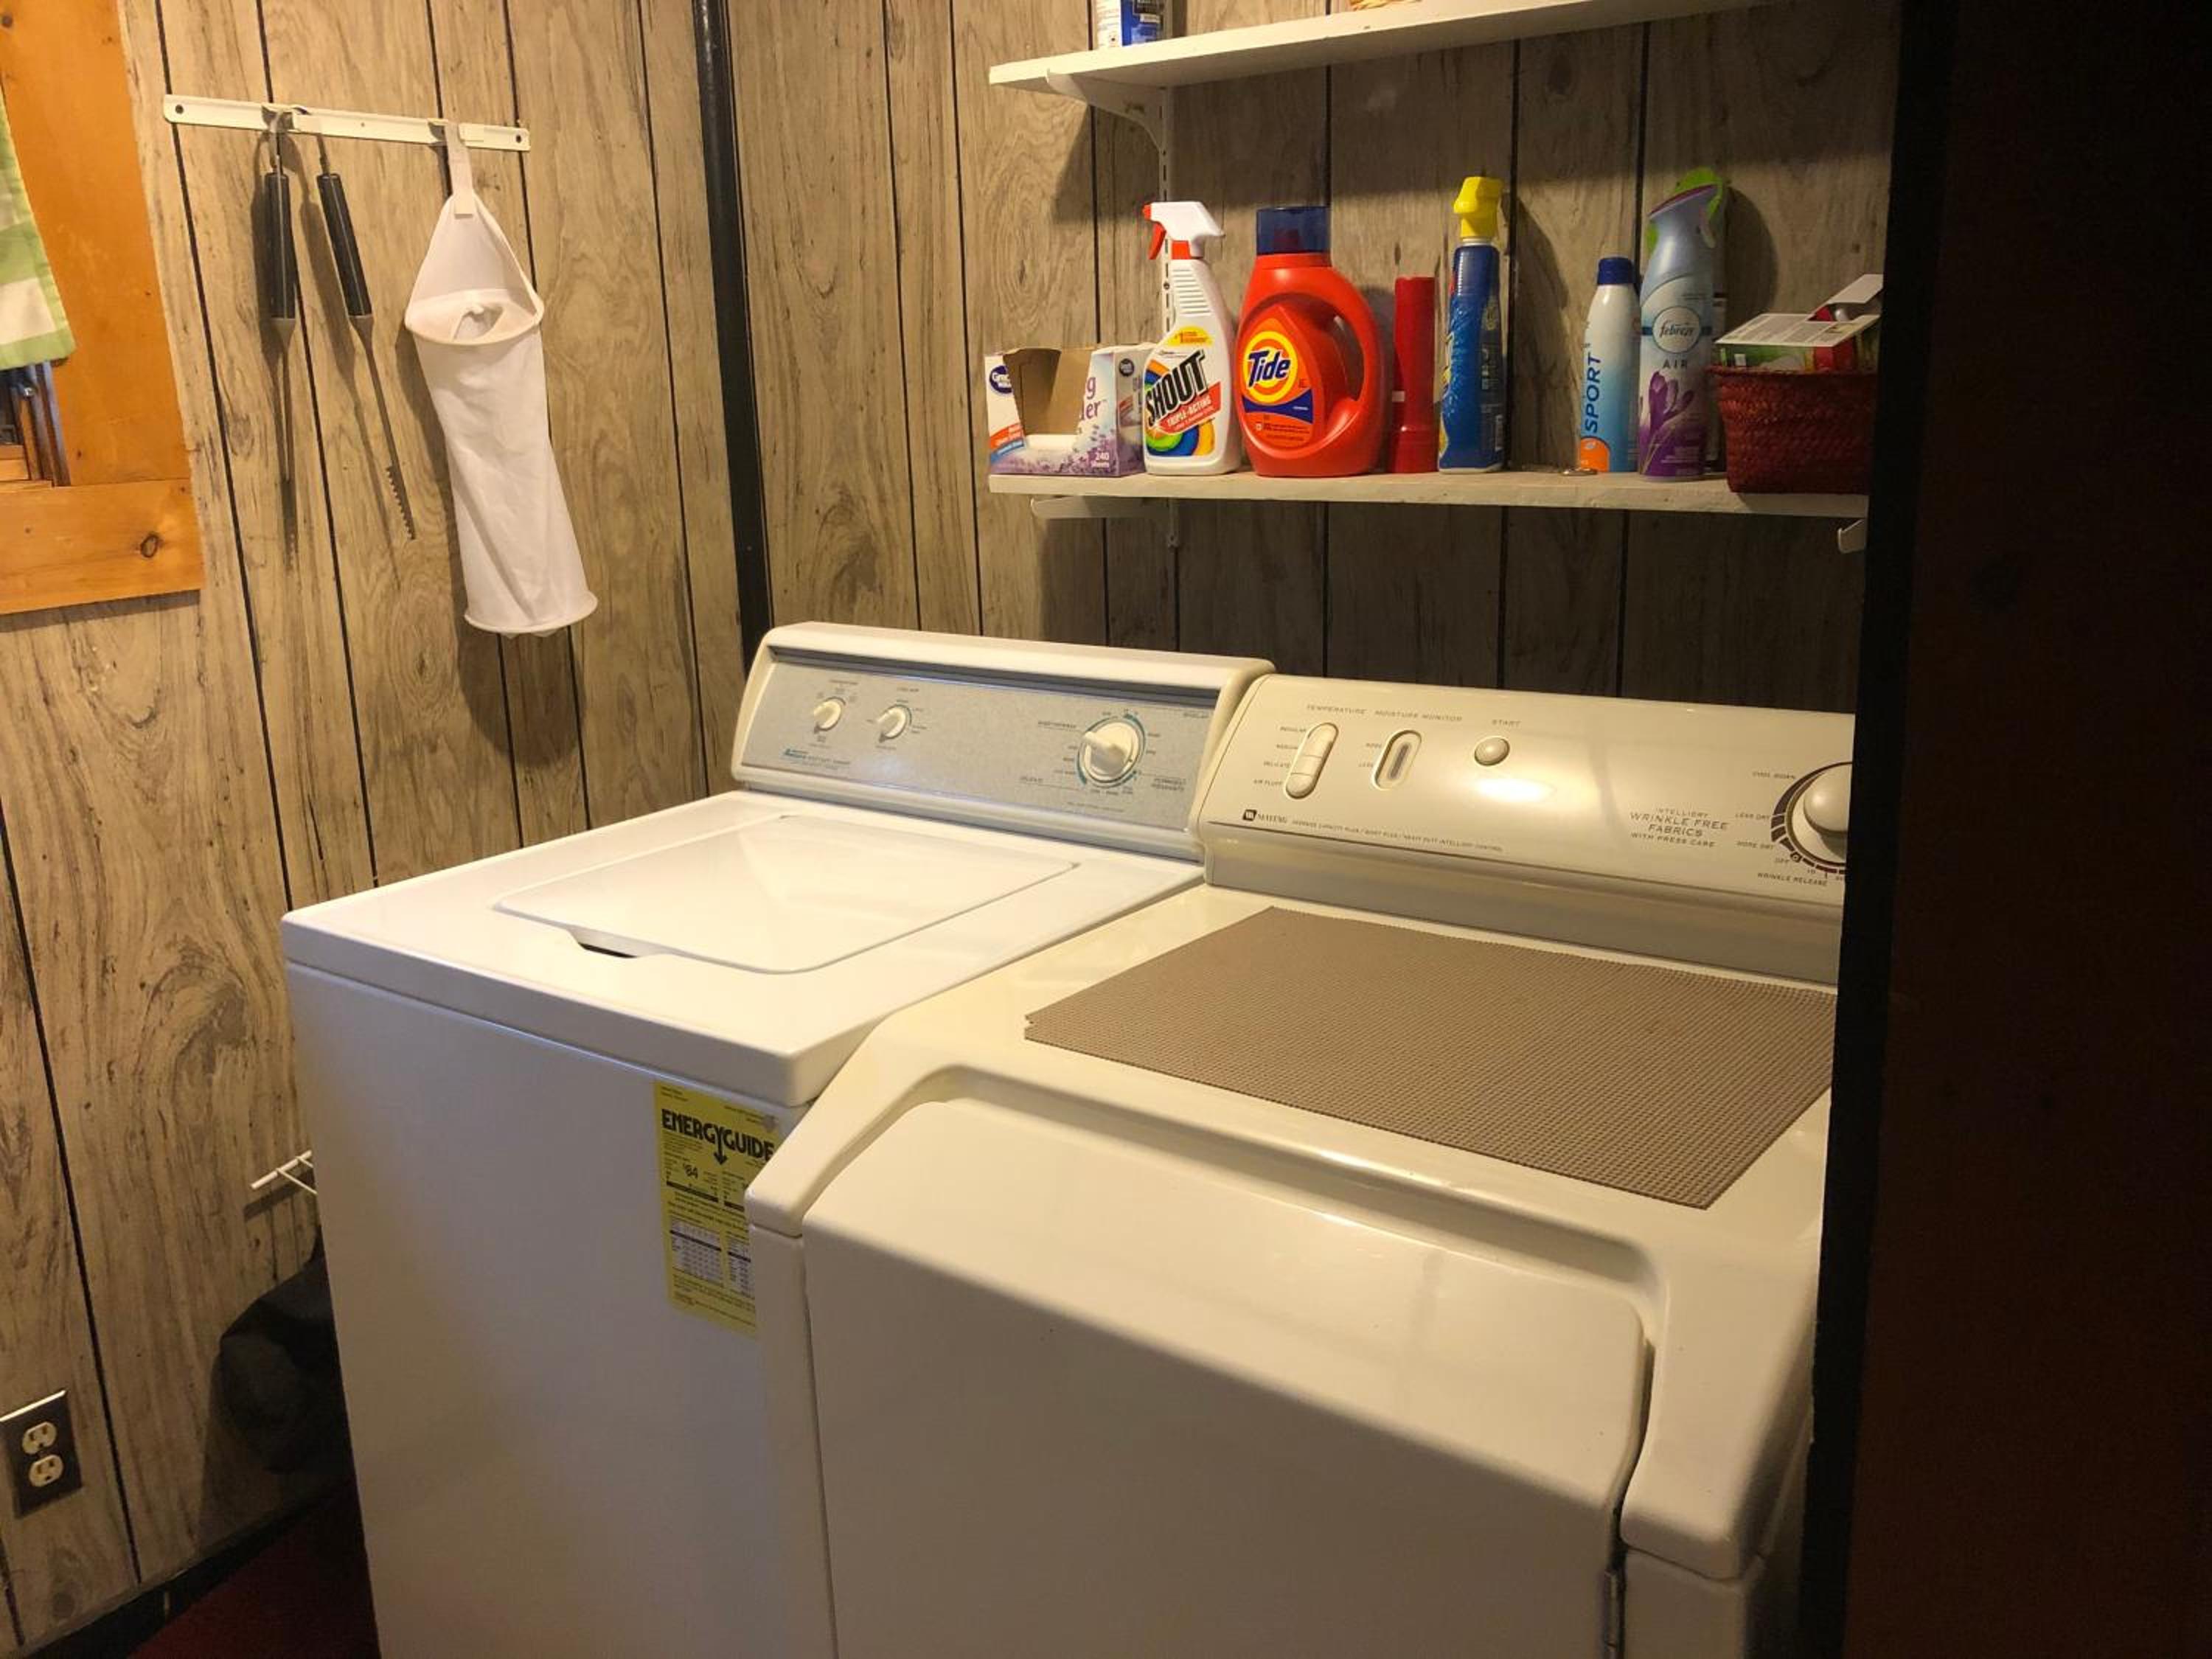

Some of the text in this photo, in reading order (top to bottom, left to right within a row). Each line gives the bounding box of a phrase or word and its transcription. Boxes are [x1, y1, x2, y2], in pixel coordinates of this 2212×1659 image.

[1248, 349, 1291, 388] Tide
[1662, 359, 1688, 369] AIR
[1145, 348, 1209, 428] SHOUT
[1585, 352, 1601, 434] SPORT
[1095, 452, 1110, 461] 240
[1307, 703, 1368, 715] TEMPERATURE
[1374, 709, 1463, 722] MOISTURE MONITOR
[1491, 718, 1522, 727] START
[1630, 812, 1730, 830] WRINKLE FREE
[1648, 824, 1703, 838] FABRICS
[1630, 832, 1717, 848] WITH PRESS CARE
[1757, 872, 1792, 883] WRINKLE
[1792, 875, 1828, 886] RELEASE
